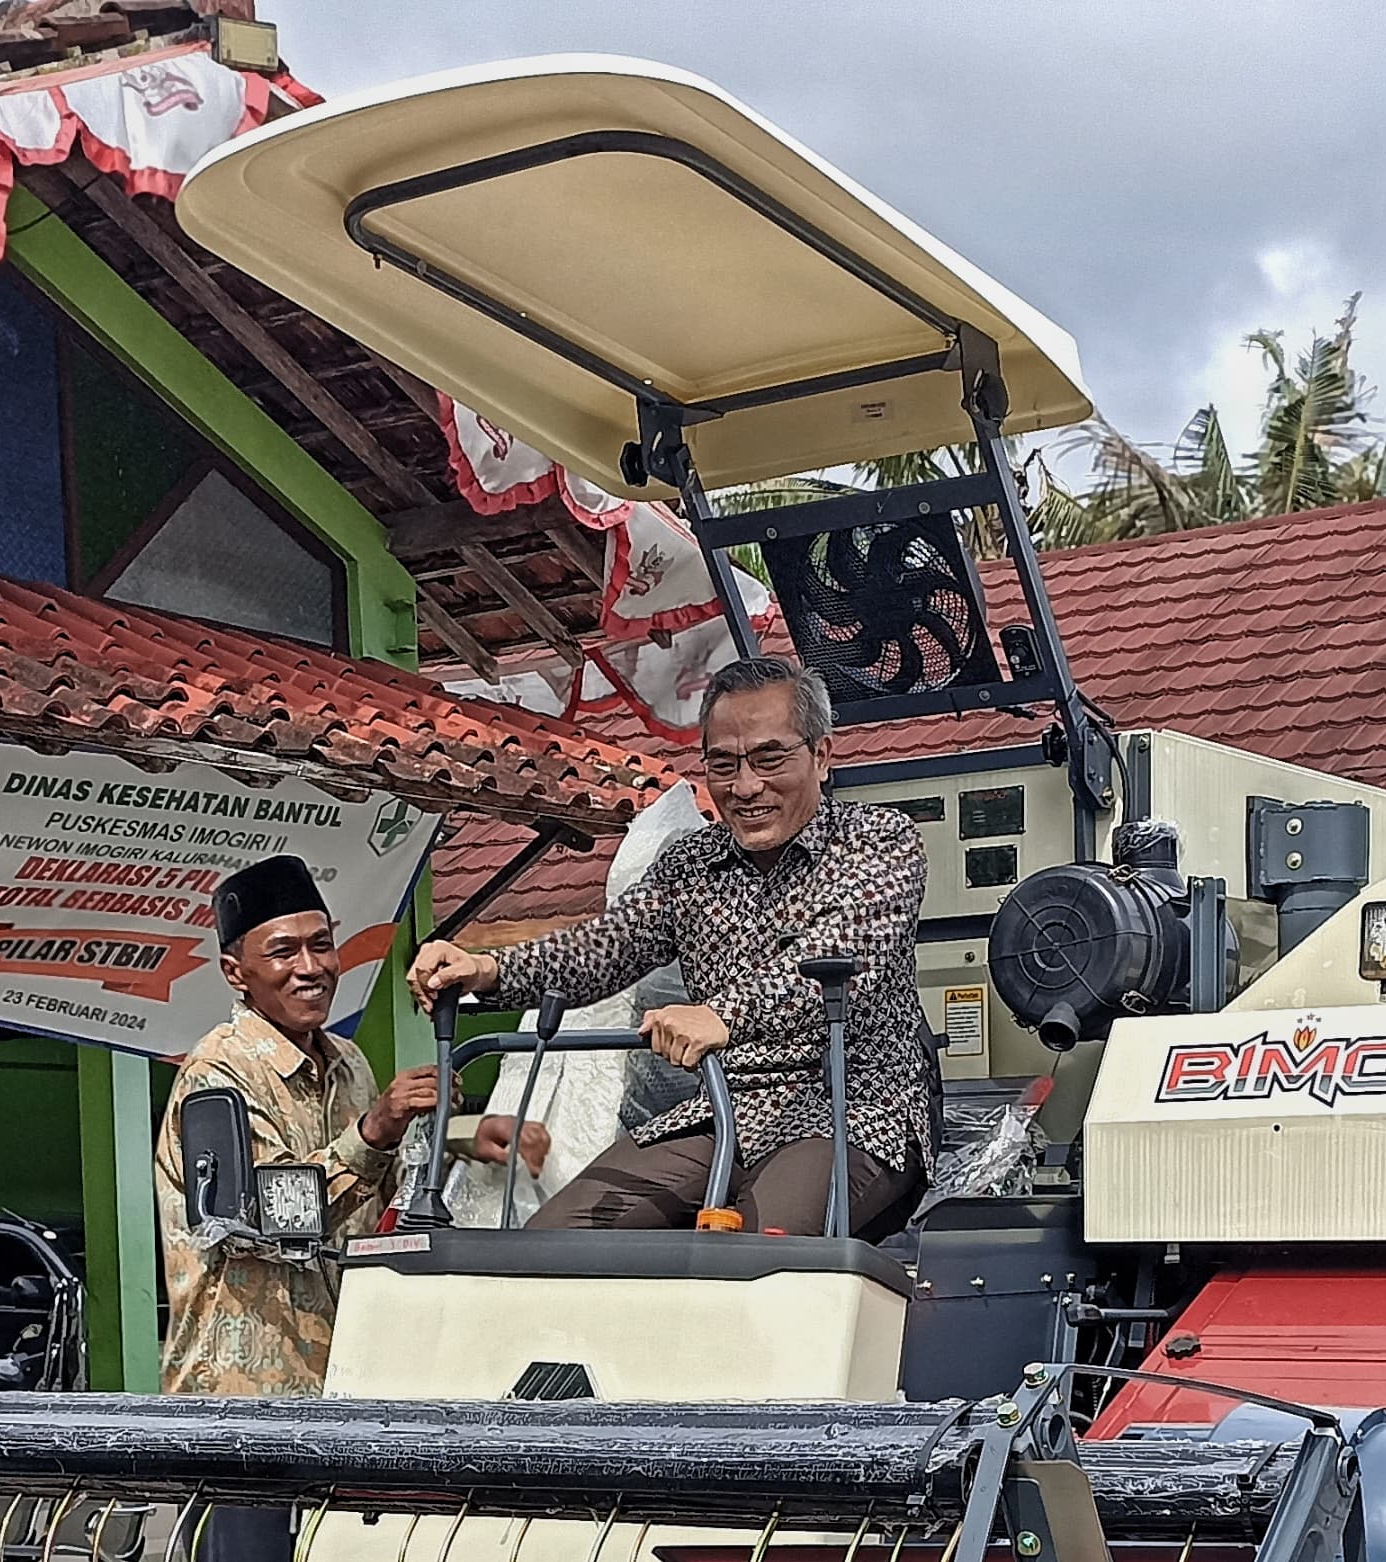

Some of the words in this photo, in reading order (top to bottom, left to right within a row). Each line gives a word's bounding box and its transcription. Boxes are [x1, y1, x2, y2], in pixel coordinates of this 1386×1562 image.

[2, 771, 93, 801] DINAS
[96, 781, 252, 819] KESEHATAN
[253, 798, 343, 828] BANTUL
[44, 811, 187, 844] PUSKESMAS
[187, 826, 271, 852] IMOGIRI
[271, 836, 288, 854] II
[74, 841, 145, 861] IMOGIRI
[14, 855, 163, 889] DEKLARASI
[160, 868, 183, 890] 5
[180, 868, 221, 896] PIL
[59, 889, 191, 922] BERBASIS
[76, 939, 169, 971] STBM
[2, 989, 24, 1005] 23
[25, 994, 109, 1022] FEBRUARI
[108, 1010, 148, 1032] 2024
